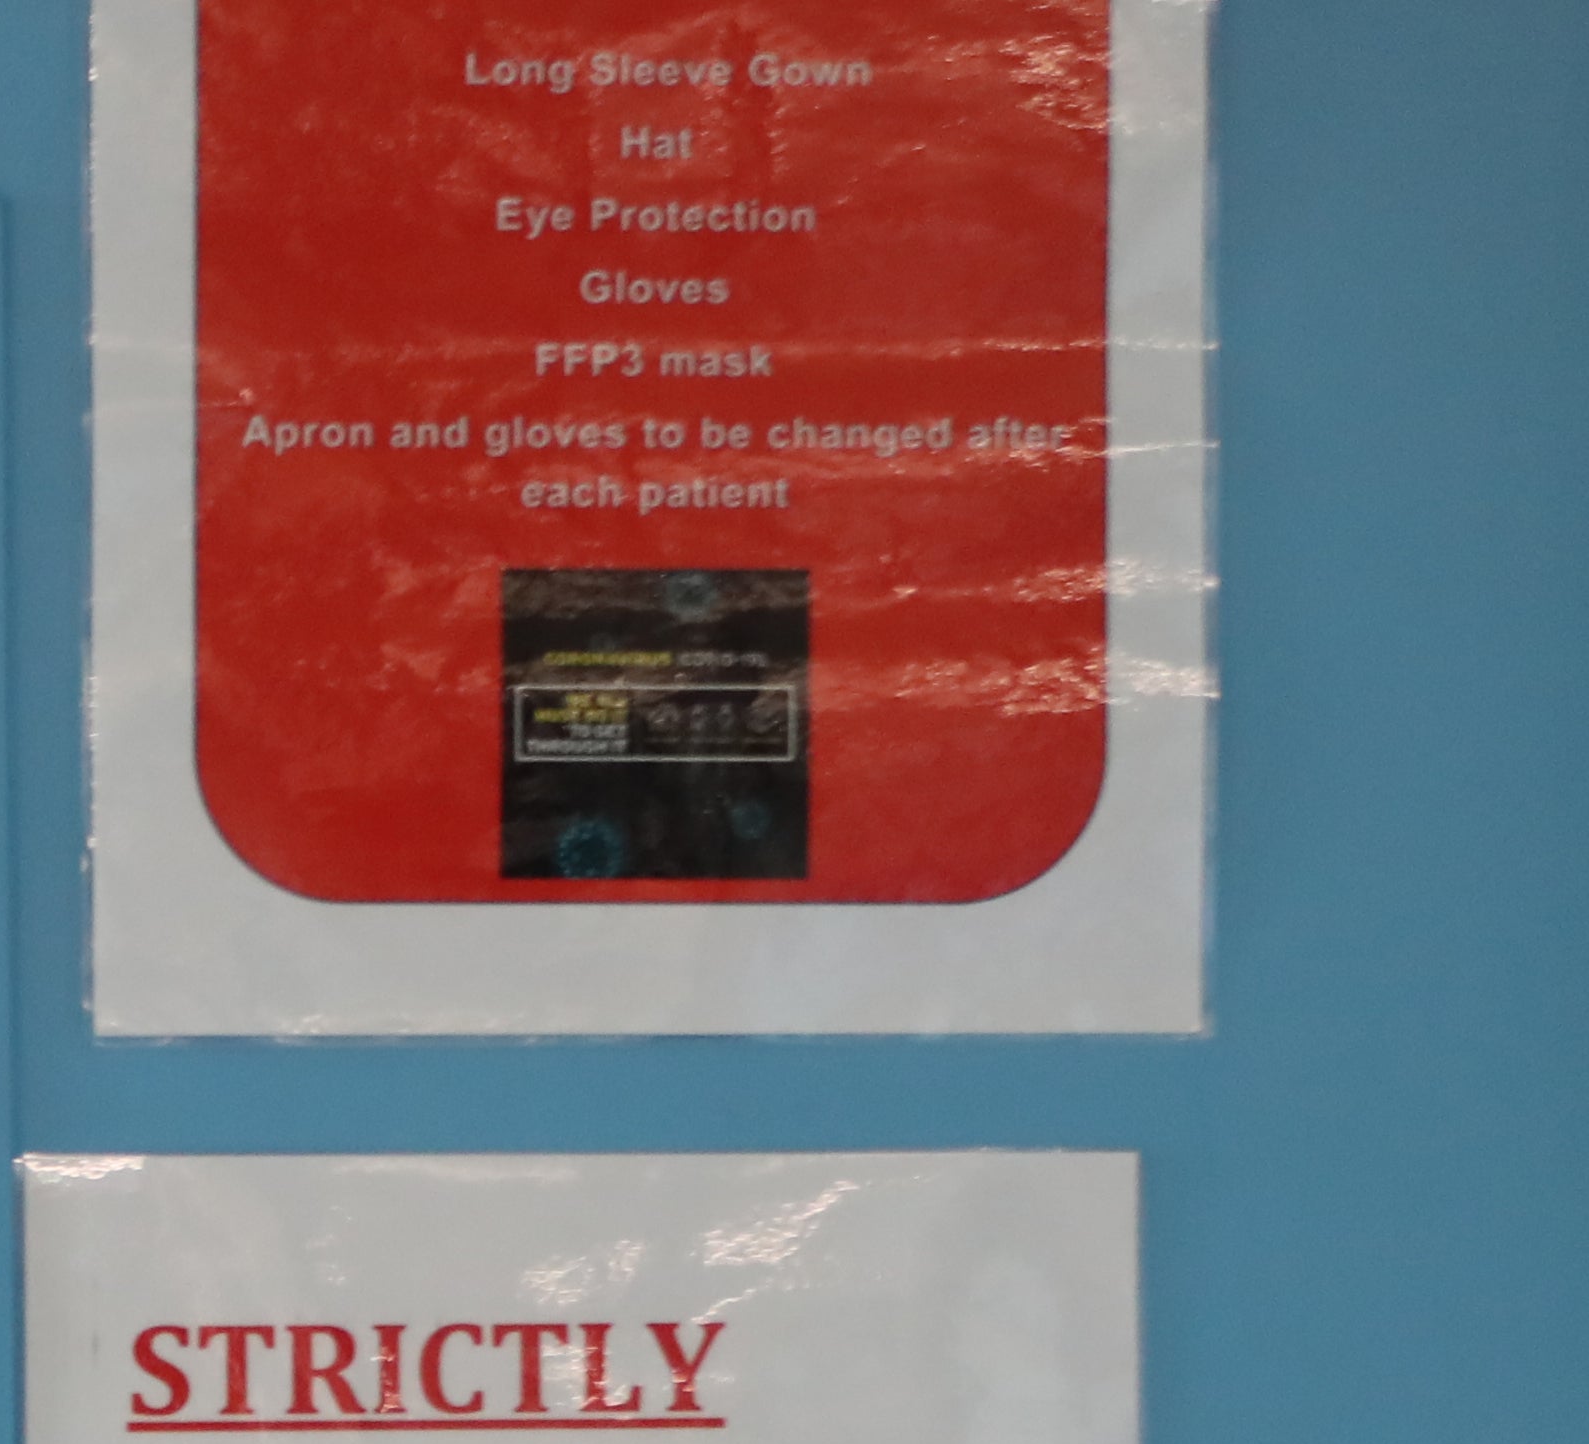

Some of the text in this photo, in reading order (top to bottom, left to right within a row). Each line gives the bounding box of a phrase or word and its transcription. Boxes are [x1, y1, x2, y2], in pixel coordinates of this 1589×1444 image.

[465, 51, 872, 94] Long Sleeve Gown
[621, 127, 692, 160] Hat
[495, 197, 815, 239] Eye Protection
[580, 269, 729, 304] Gloves
[535, 342, 771, 376] FFP3 mask
[242, 415, 1068, 457] Apron and gloves to be changed after
[521, 475, 789, 517] each patient
[128, 1322, 725, 1420] STRICTLY
